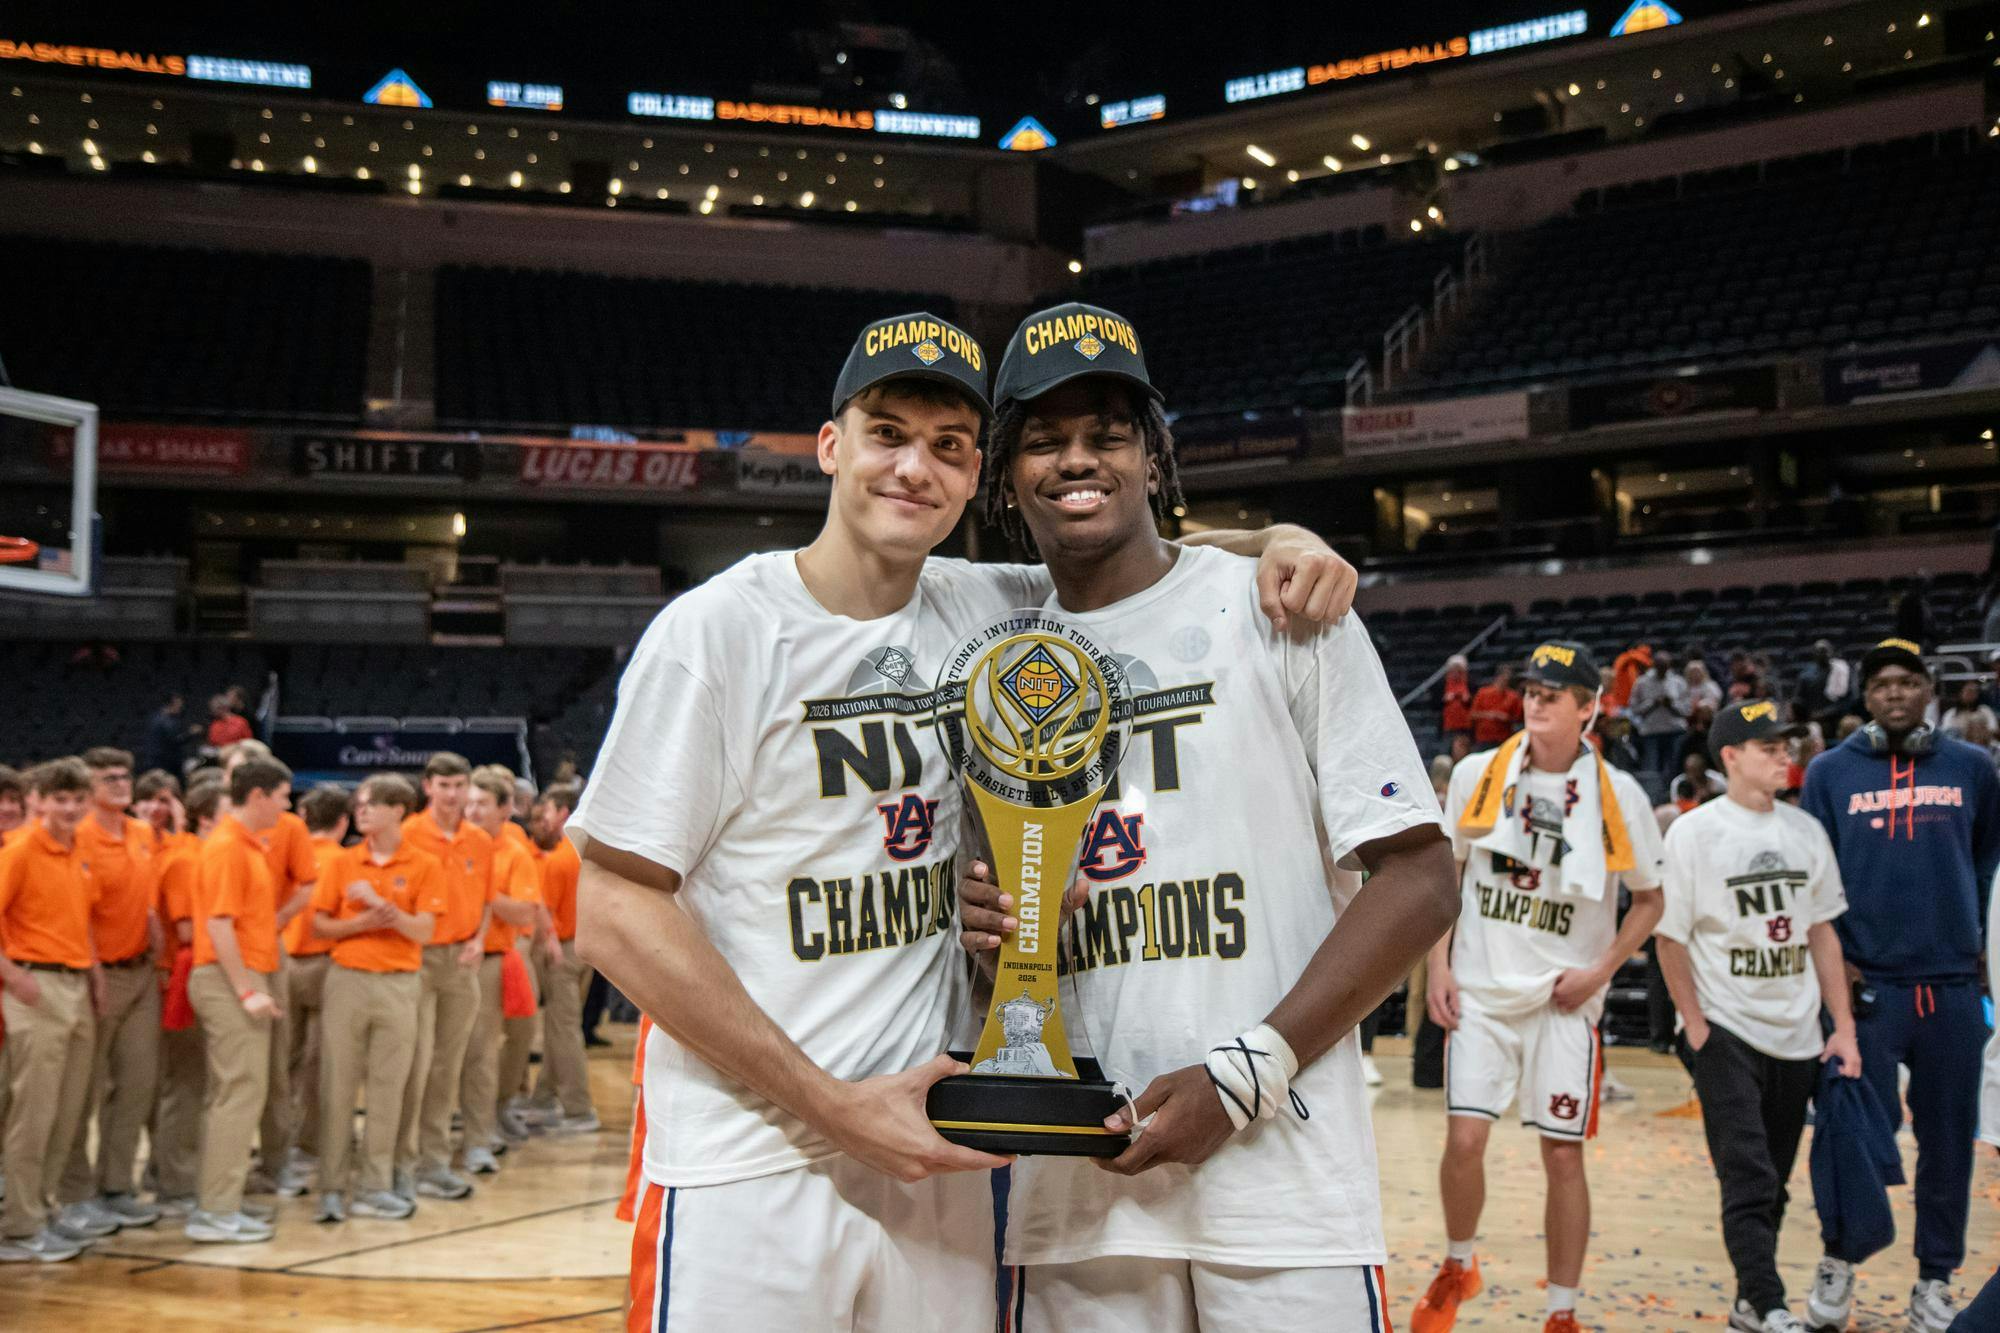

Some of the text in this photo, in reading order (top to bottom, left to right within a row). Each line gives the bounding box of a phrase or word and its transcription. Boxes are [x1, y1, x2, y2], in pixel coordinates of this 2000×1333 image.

[865, 319, 982, 372] CHAMPIONS
[1025, 314, 1138, 356] CHAMPIONS
[305, 441, 455, 471] SHIFT 4
[522, 449, 699, 484] LUCAS OIL
[741, 461, 822, 486] KeyBa
[943, 637, 984, 699] NATIONAL
[984, 618, 1065, 640] INVITATION
[1020, 676, 1059, 692] NIT
[808, 704, 829, 718] 2026
[832, 699, 882, 716] NATIONAL
[884, 696, 916, 712] INVON
[1042, 715, 1084, 741] NATINAL
[1137, 687, 1205, 711] TOURNAMENT
[338, 746, 429, 766] CareSou
[1070, 730, 1120, 792] BEGINNING
[1847, 785, 1963, 815] AUBURN
[786, 850, 957, 962] CHAMP1O
[1018, 821, 1043, 954] CHAMPION
[1057, 870, 1247, 978] AMP1ONS
[1477, 882, 1574, 936] HAMP1ONS
[1003, 961, 1053, 972] INDIANAPOLIS
[1018, 974, 1037, 983] 2026
